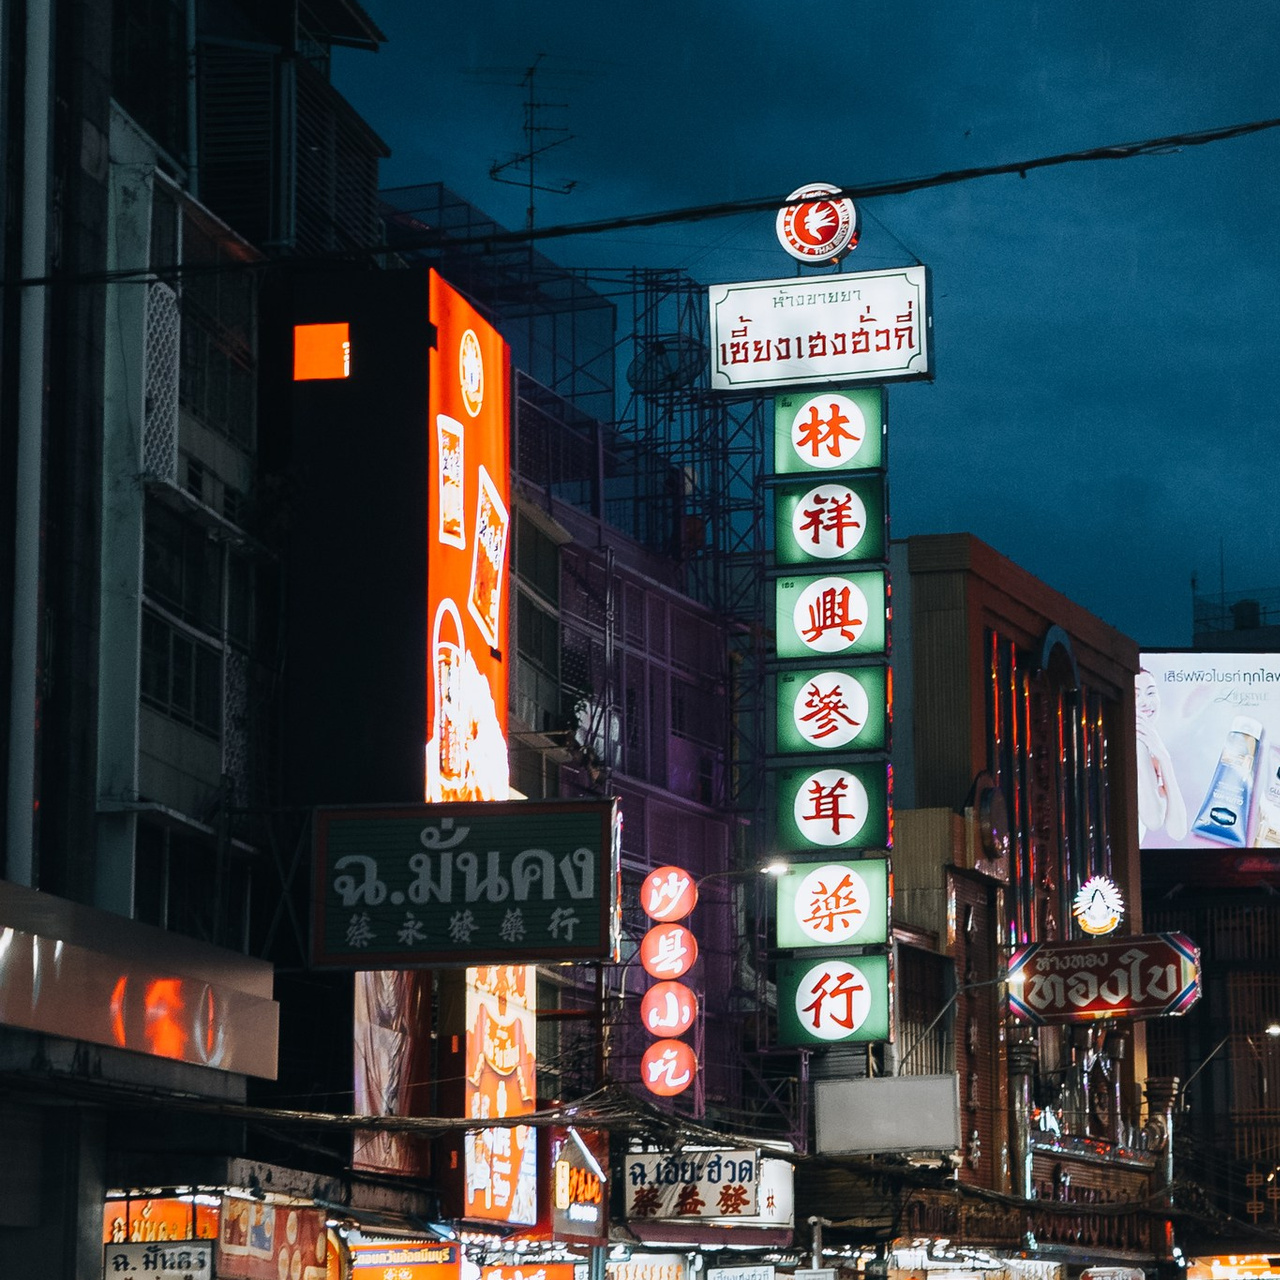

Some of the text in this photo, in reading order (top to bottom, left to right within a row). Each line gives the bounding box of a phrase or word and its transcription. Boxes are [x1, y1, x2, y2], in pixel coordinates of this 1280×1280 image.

[772, 289, 862, 308] ห้างขายยา
[333, 818, 596, 907] ฉ.มั่นคง
[1027, 948, 1178, 1011] ทองใบ
[1035, 951, 1109, 971] ห้างทอง
